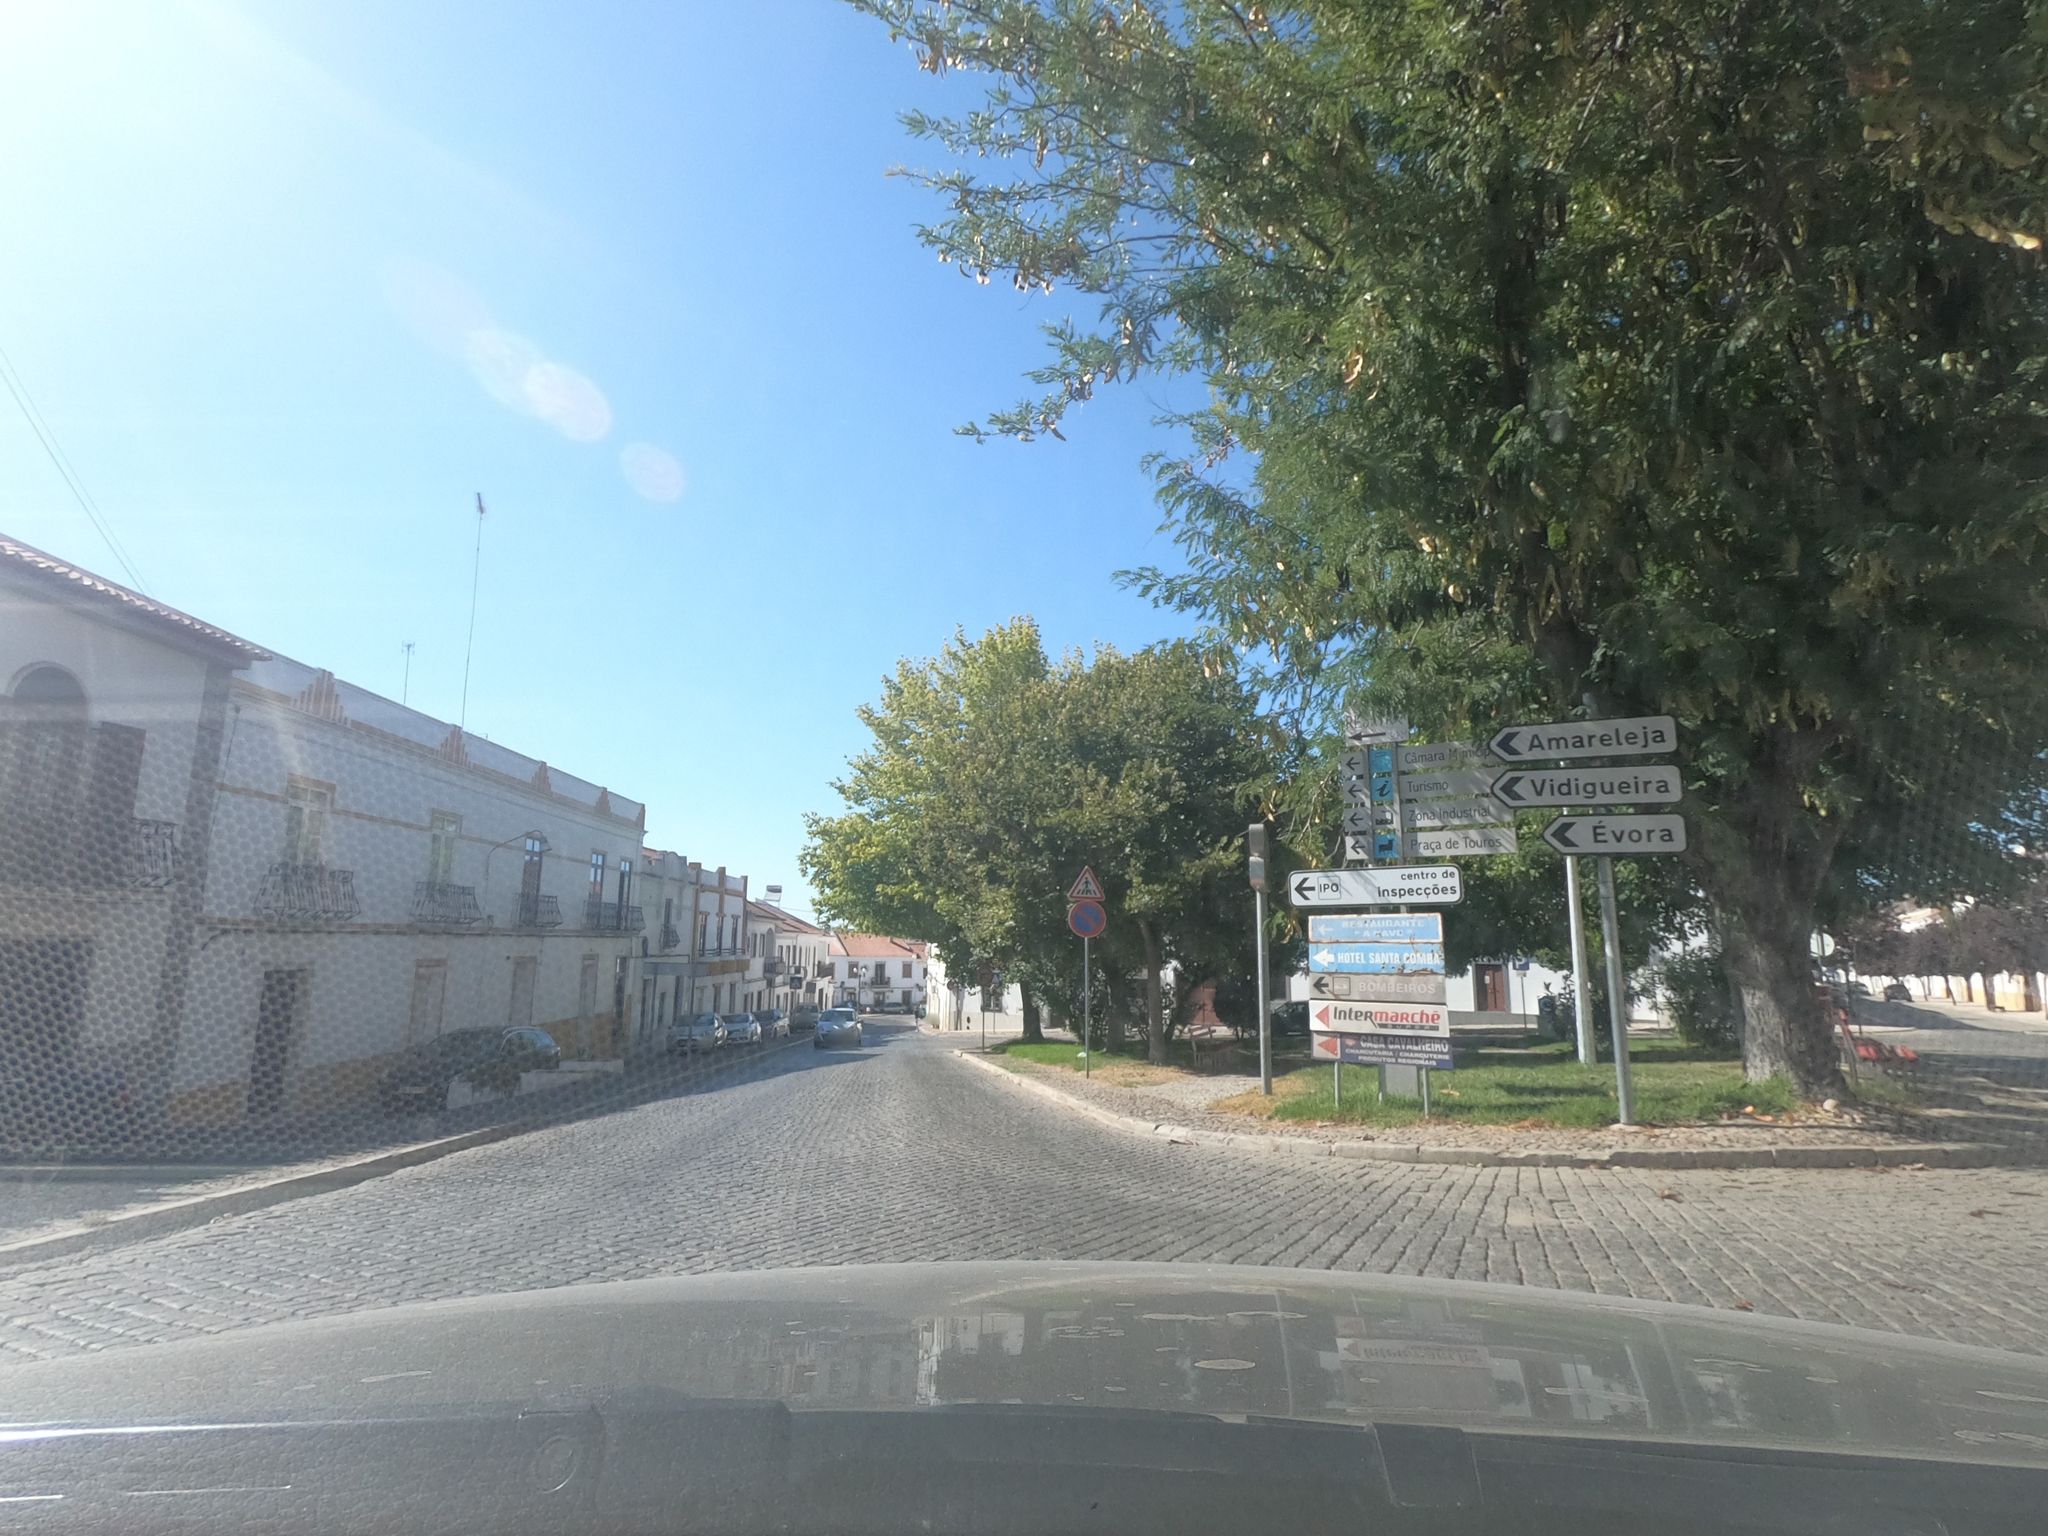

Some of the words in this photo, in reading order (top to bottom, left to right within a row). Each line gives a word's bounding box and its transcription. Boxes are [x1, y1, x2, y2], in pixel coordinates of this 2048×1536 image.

[1528, 726, 1666, 751] Amareleja
[1404, 751, 1445, 764] Câmara
[1407, 780, 1449, 792] Turismo
[1530, 776, 1671, 799] Vidigueira
[1408, 809, 1435, 821] Zona
[1439, 807, 1490, 820] Industrial
[1592, 820, 1674, 844] Évora
[1410, 839, 1442, 853] Praça
[1445, 838, 1459, 849] de
[1463, 836, 1502, 849] Touros
[1401, 871, 1437, 881] centro
[1442, 869, 1456, 879] de
[1319, 883, 1339, 893] IPO
[1338, 952, 1365, 964] HOTEL
[1369, 953, 1400, 964] SANTA
[1404, 952, 1441, 965] COMBA
[1359, 981, 1436, 994] BOMBEIROS
[1360, 1035, 1385, 1049] CASA
[1388, 1037, 1449, 1052] CAVALHEIRO
